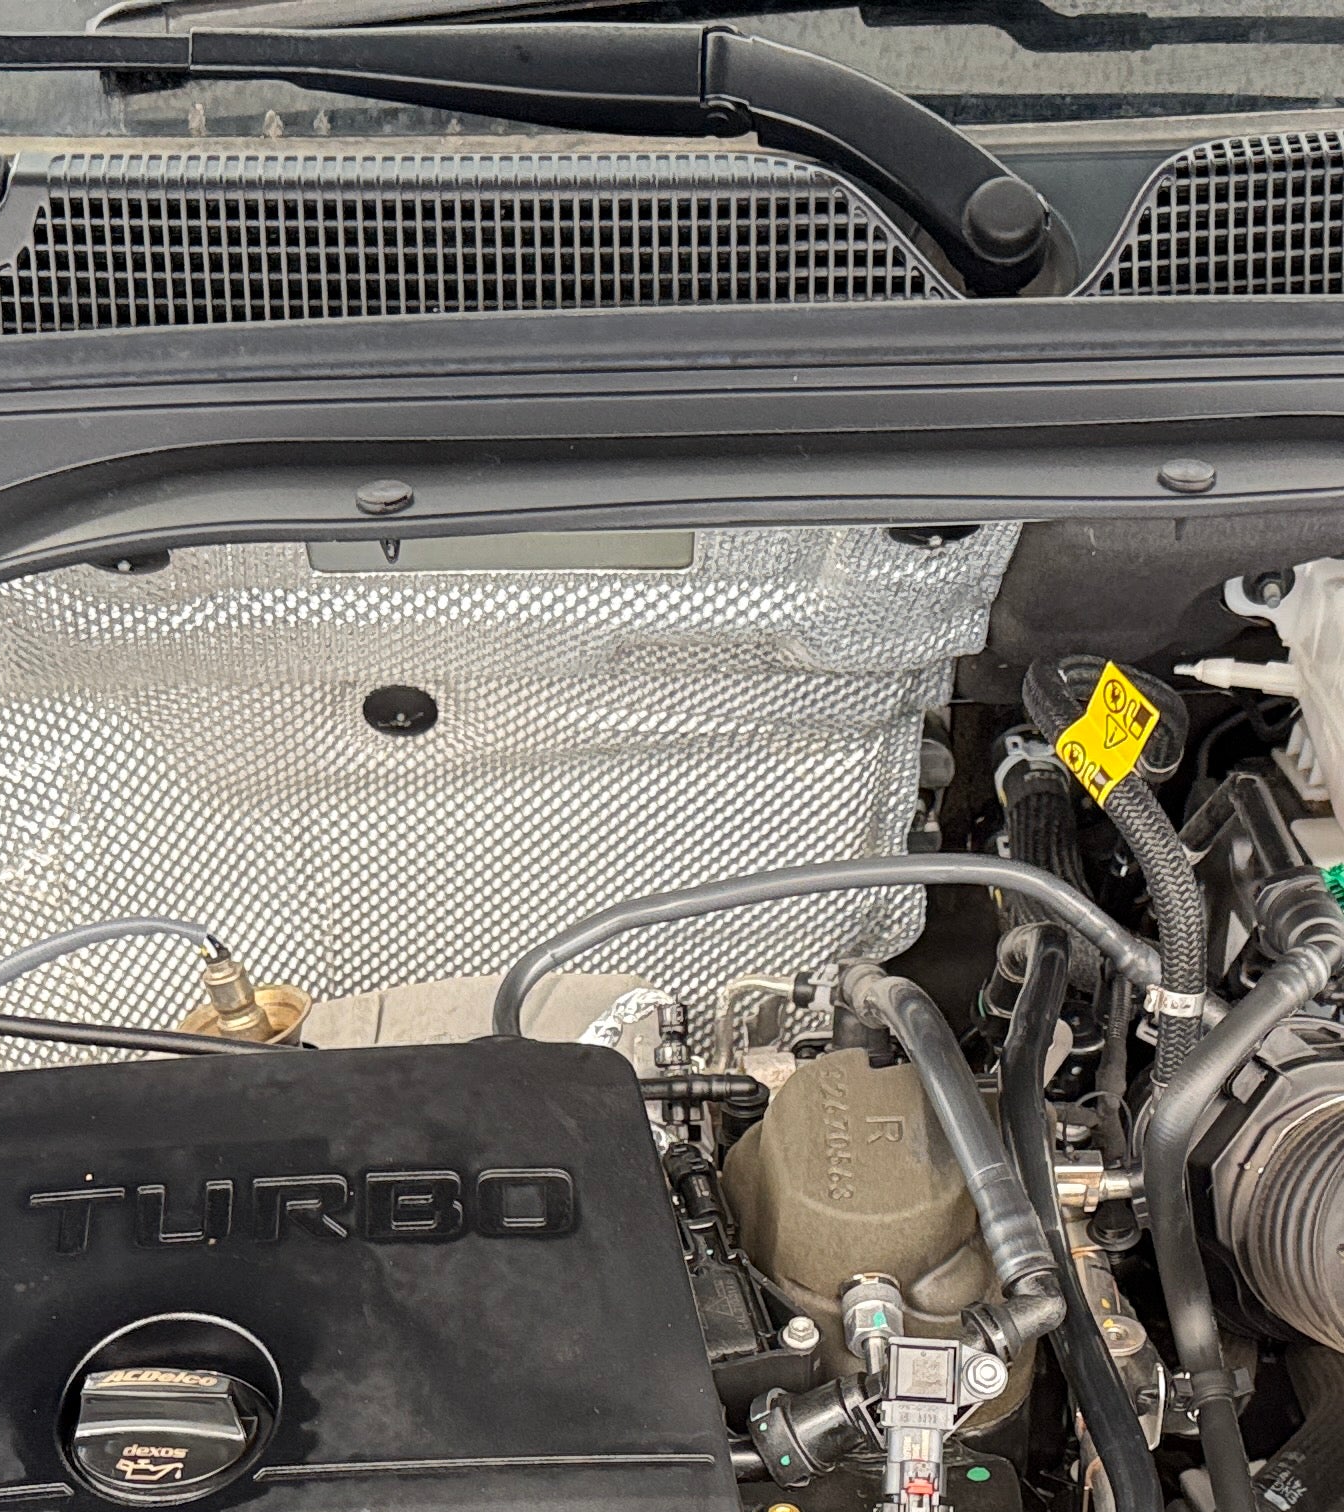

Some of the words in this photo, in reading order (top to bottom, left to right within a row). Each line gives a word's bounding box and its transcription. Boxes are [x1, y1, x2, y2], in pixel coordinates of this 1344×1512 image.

[865, 1115, 906, 1146] R
[29, 1167, 576, 1257] TURBO
[101, 1369, 219, 1388] ACDelco
[122, 1443, 189, 1459] dexos
